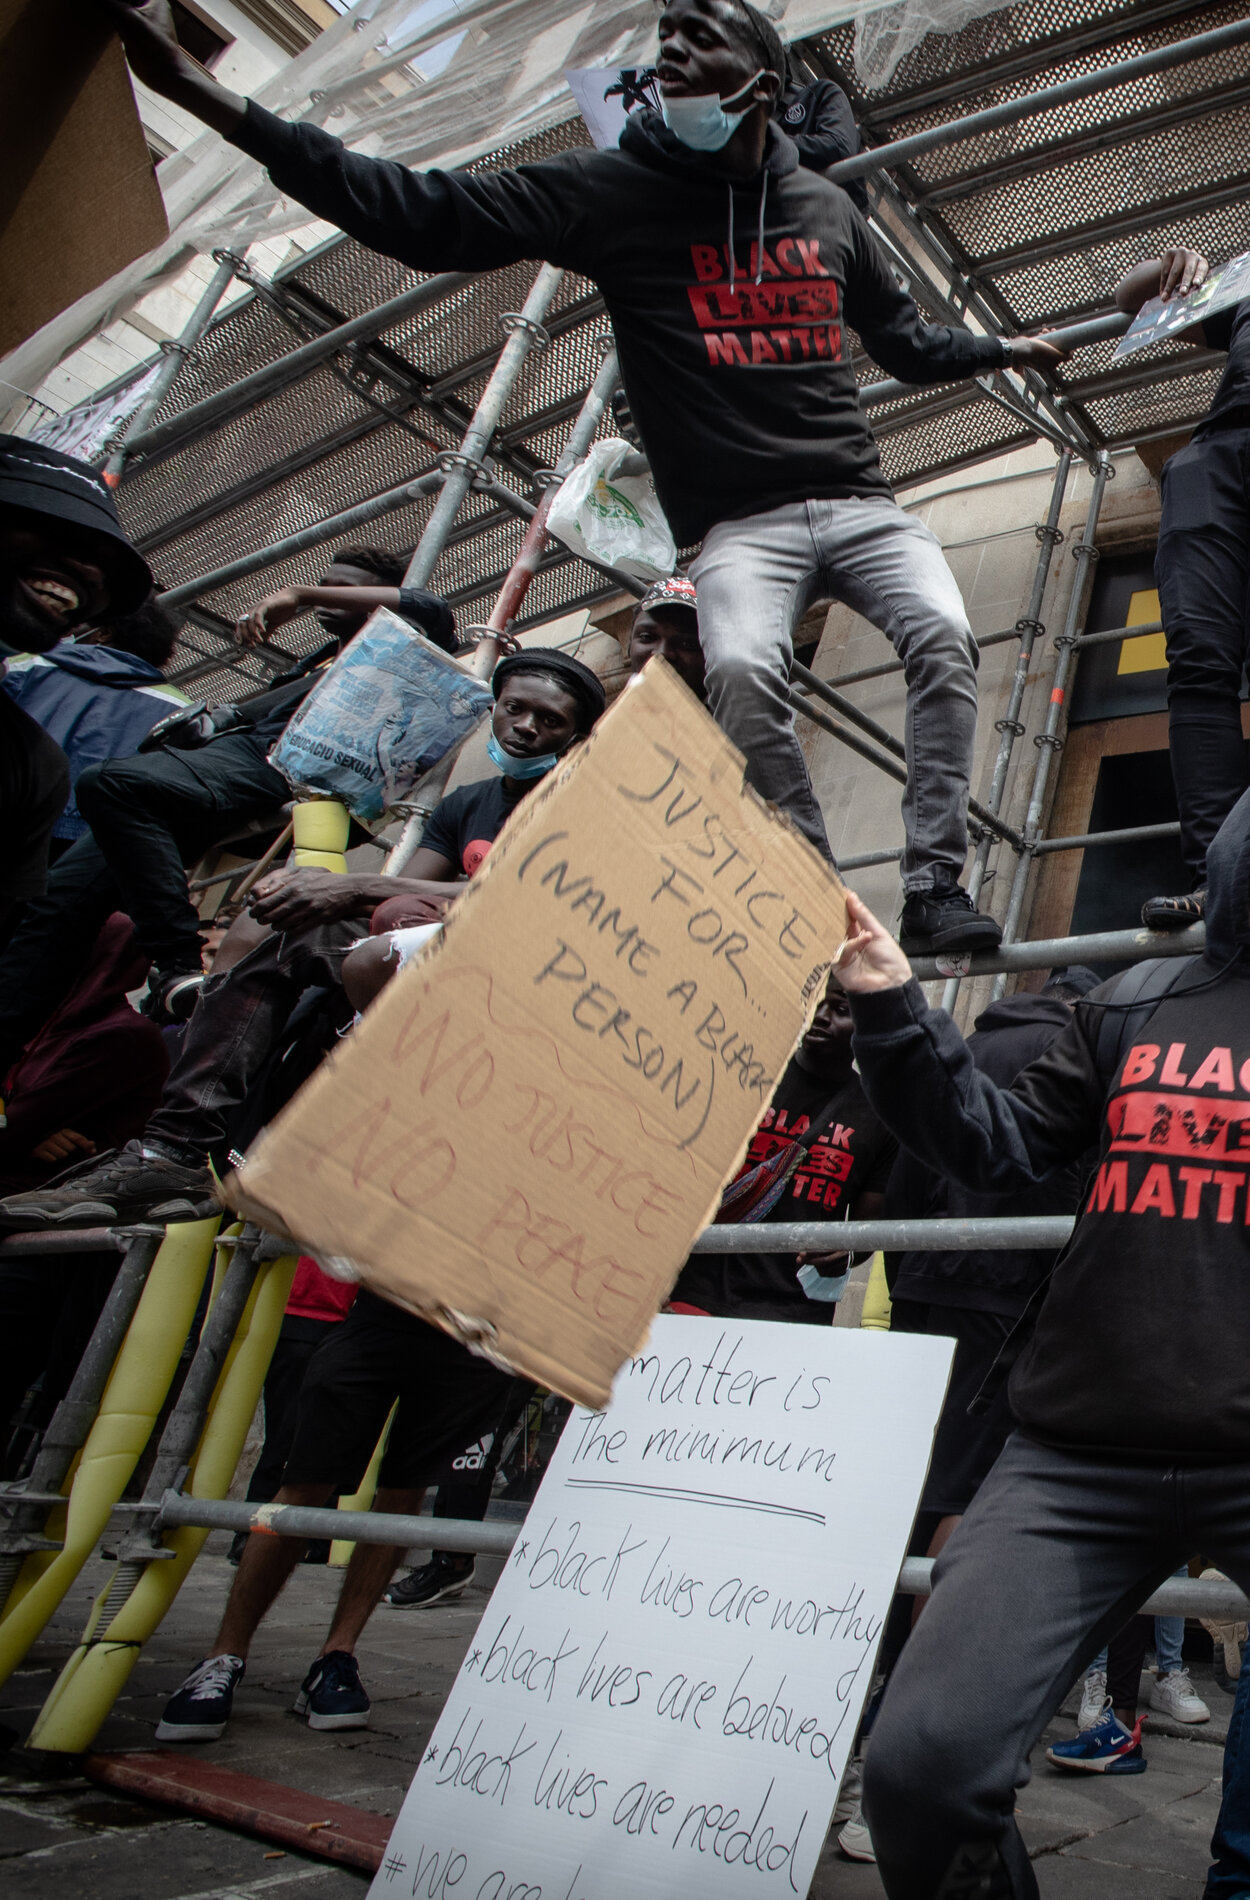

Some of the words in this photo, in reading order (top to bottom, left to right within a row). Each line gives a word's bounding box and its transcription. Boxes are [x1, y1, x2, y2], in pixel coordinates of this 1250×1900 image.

[690, 238, 830, 282] BLACK
[704, 287, 834, 321] LIVES
[703, 325, 842, 366] MATTER
[333, 751, 379, 783] SEXUAL
[518, 831, 662, 977] (NAME
[666, 979, 698, 1016] A
[629, 1331, 777, 1407] matter
[783, 1368, 831, 1412] is
[641, 1423, 837, 1482] minimum
[640, 1535, 704, 1618] lives
[708, 1577, 770, 1627] are
[770, 1581, 883, 1702] worthy
[576, 1630, 653, 1707] lives
[656, 1673, 717, 1729] are
[722, 1655, 851, 1781] beloved
[533, 1729, 609, 1819] lives
[612, 1781, 675, 1836] are
[672, 1777, 809, 1893] needed
